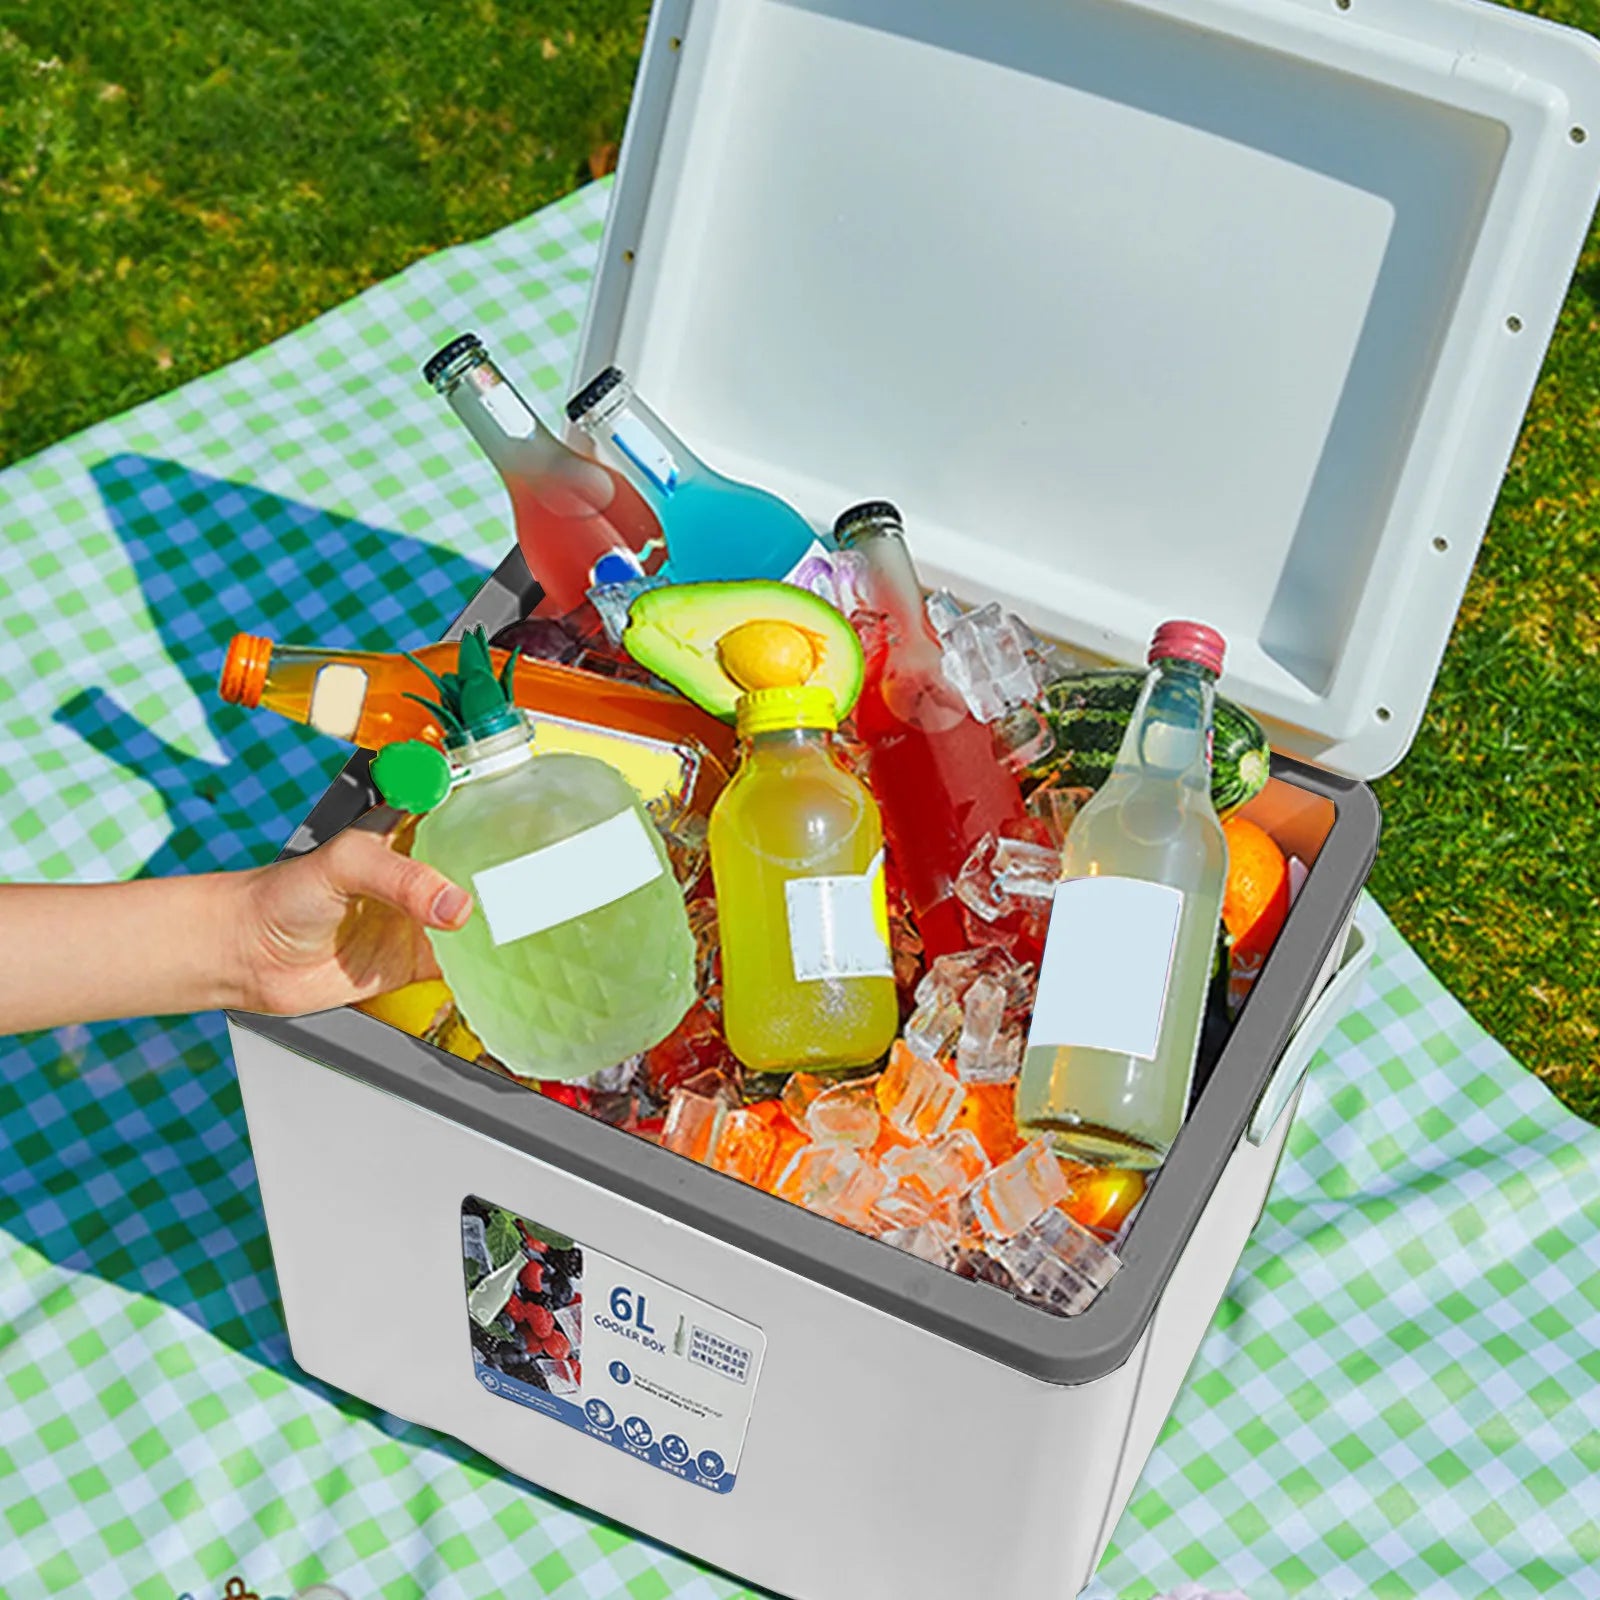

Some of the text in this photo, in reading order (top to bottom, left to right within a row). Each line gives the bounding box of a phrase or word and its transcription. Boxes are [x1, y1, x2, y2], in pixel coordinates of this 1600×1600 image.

[610, 1286, 655, 1334] 6L
[594, 1315, 640, 1343] COOLER
[642, 1336, 667, 1356] BOX
